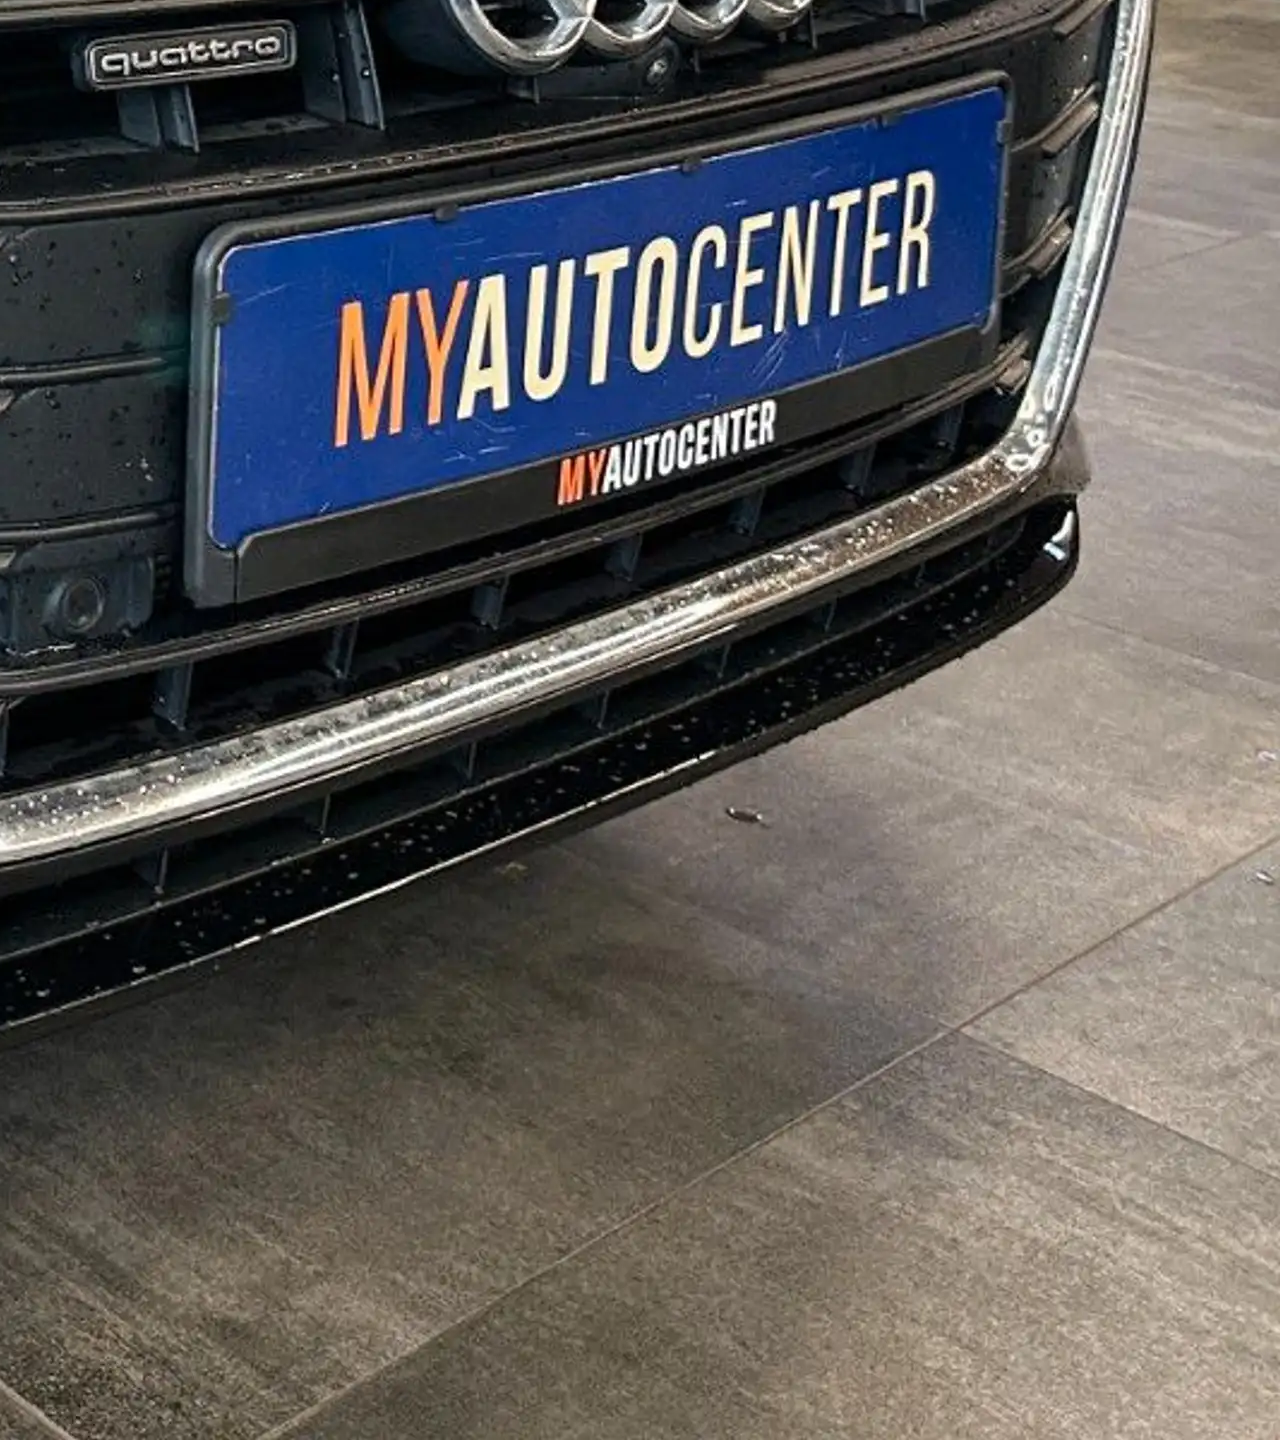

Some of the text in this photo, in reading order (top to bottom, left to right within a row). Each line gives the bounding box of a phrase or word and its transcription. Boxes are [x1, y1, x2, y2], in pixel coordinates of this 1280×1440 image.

[101, 35, 282, 76] quattro
[333, 169, 936, 447] MYAUTOCENTER
[557, 398, 777, 506] MYAUTOCENTER
